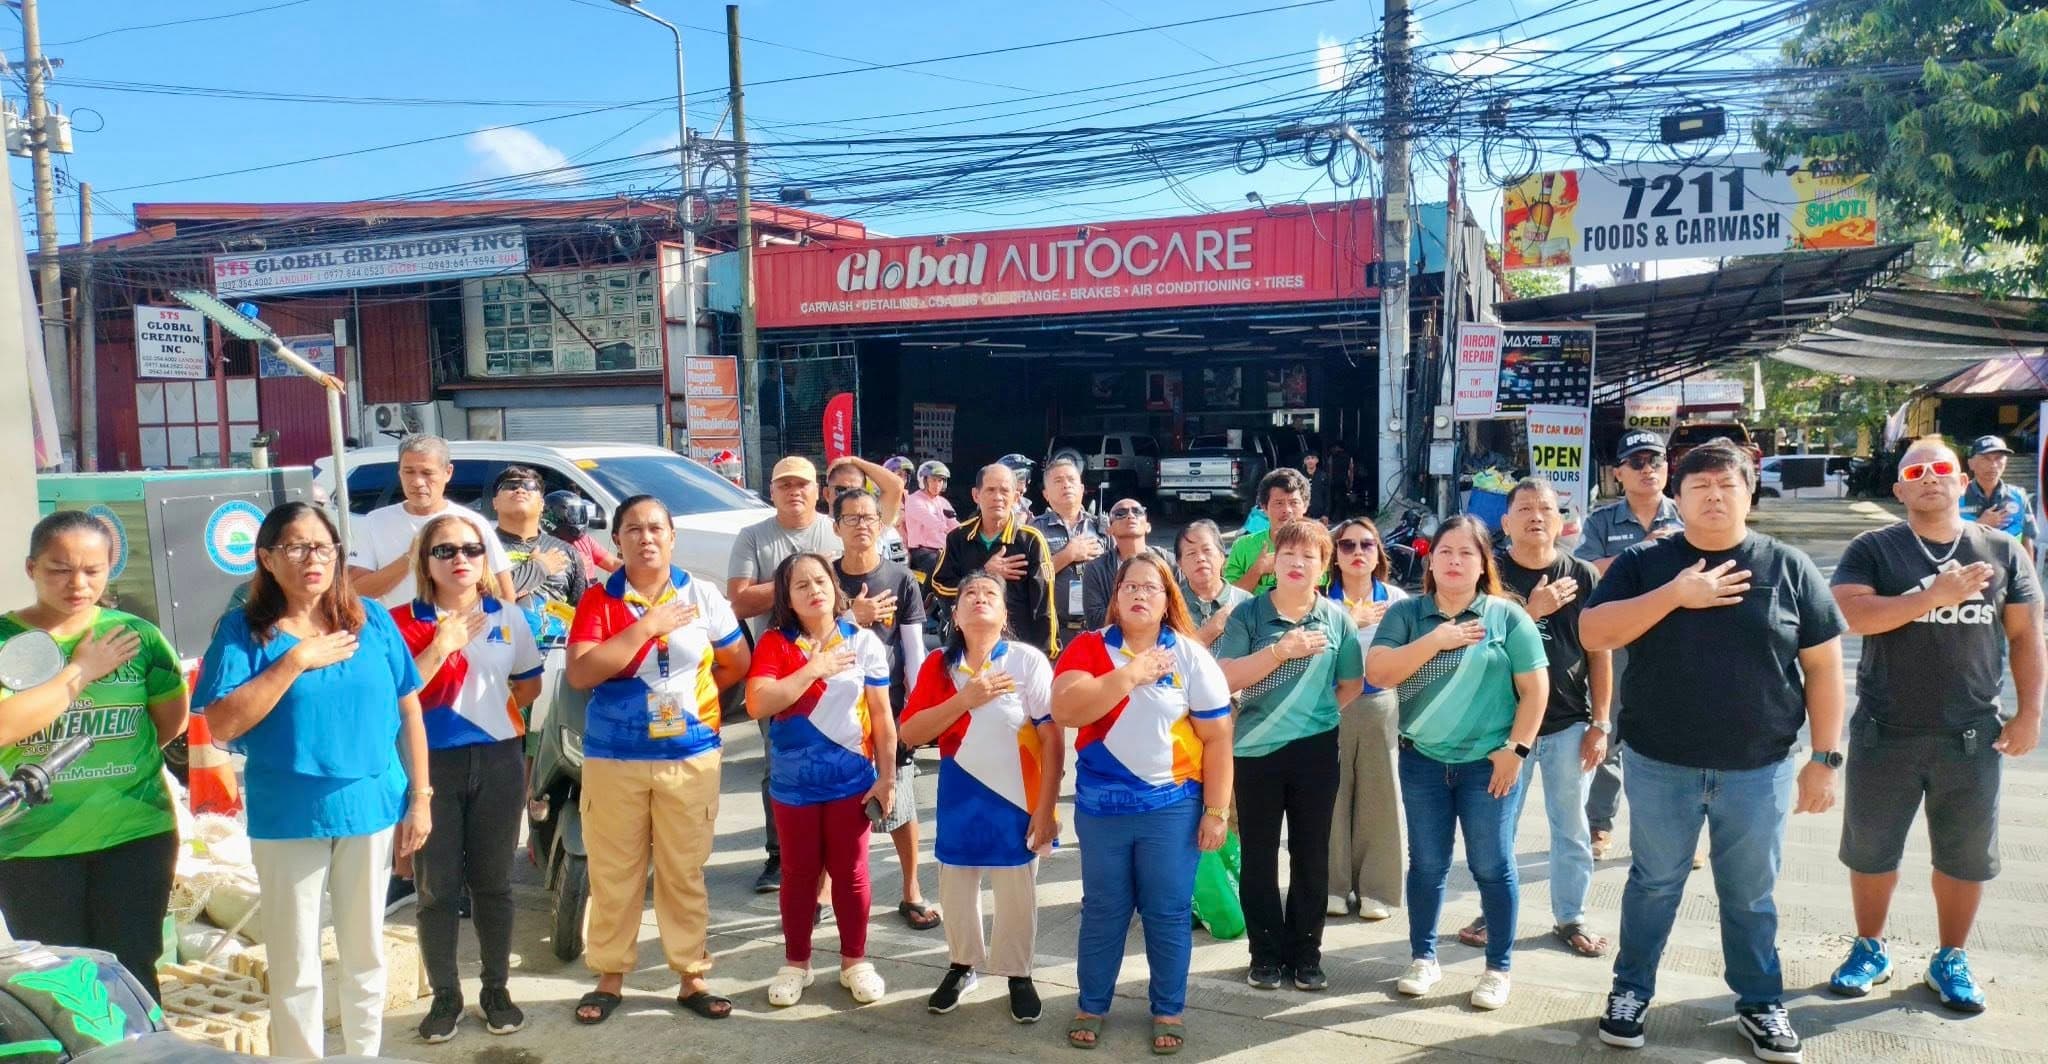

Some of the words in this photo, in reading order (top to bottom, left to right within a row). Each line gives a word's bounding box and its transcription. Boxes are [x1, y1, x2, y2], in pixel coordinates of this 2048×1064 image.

[1618, 167, 1744, 219] 7211
[1583, 222, 1648, 252] FOODS
[1655, 225, 1668, 247] &
[1677, 212, 1780, 244] CARWASH
[216, 260, 249, 277] STS
[255, 251, 337, 273] GLOBAL
[343, 237, 468, 264] CREATION,
[471, 232, 525, 252] INC.
[836, 243, 987, 292] Global
[998, 227, 1253, 282] AUTOCARE
[800, 301, 853, 313] CARWASH
[862, 296, 919, 311] DETAILING
[1070, 286, 1120, 299] BRAKES
[1131, 284, 1153, 297] AIR
[1156, 278, 1251, 295] CONDITIONING
[1264, 275, 1304, 289] TIRES
[160, 311, 180, 320] STS
[147, 321, 194, 332] GLOBAL
[141, 332, 204, 346] CREATION,
[1463, 334, 1496, 348] AIRCON
[161, 344, 185, 354] INC.
[1463, 350, 1494, 363] REPAIR
[1458, 390, 1493, 398] INSTALLATION
[1629, 416, 1671, 427] OPEN
[1626, 433, 1654, 446] BPSO
[1532, 445, 1582, 468] OPEN
